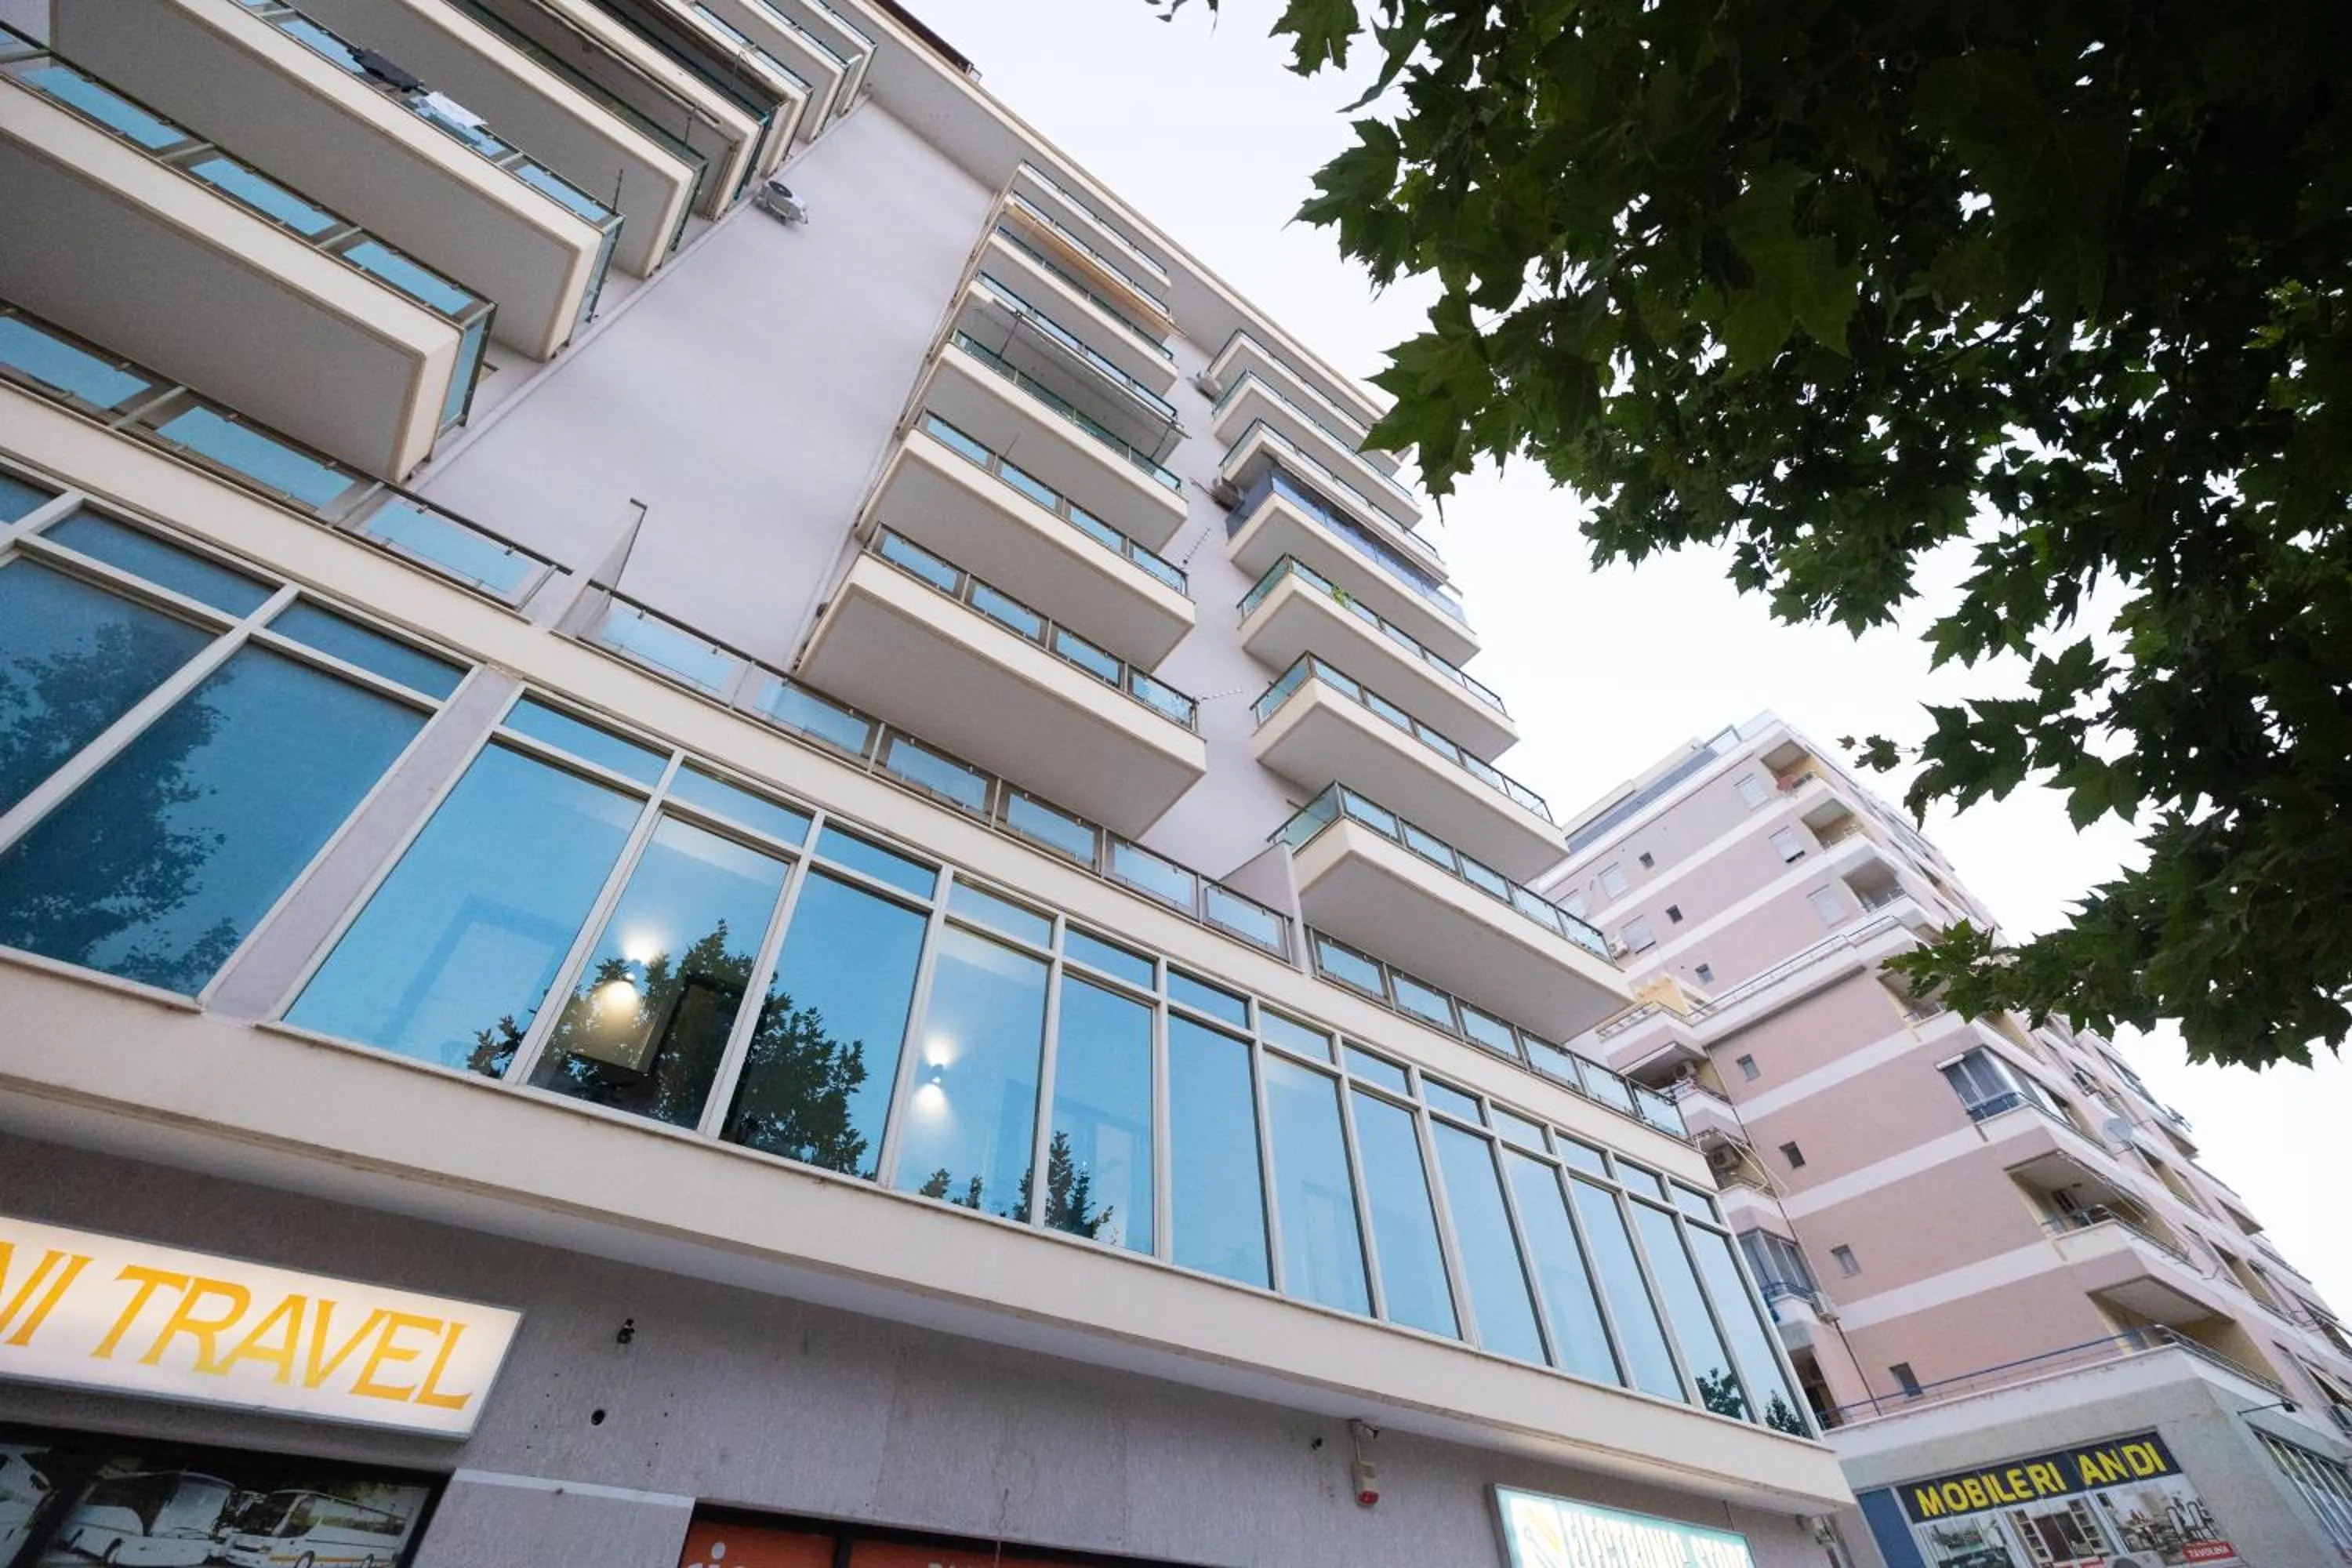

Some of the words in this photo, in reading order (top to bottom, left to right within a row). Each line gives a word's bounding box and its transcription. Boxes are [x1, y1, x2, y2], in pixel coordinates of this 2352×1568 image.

[89, 1264, 474, 1410] TRAVEL
[1915, 1461, 2067, 1518] MOBILERI
[2078, 1441, 2168, 1486] ANDI
